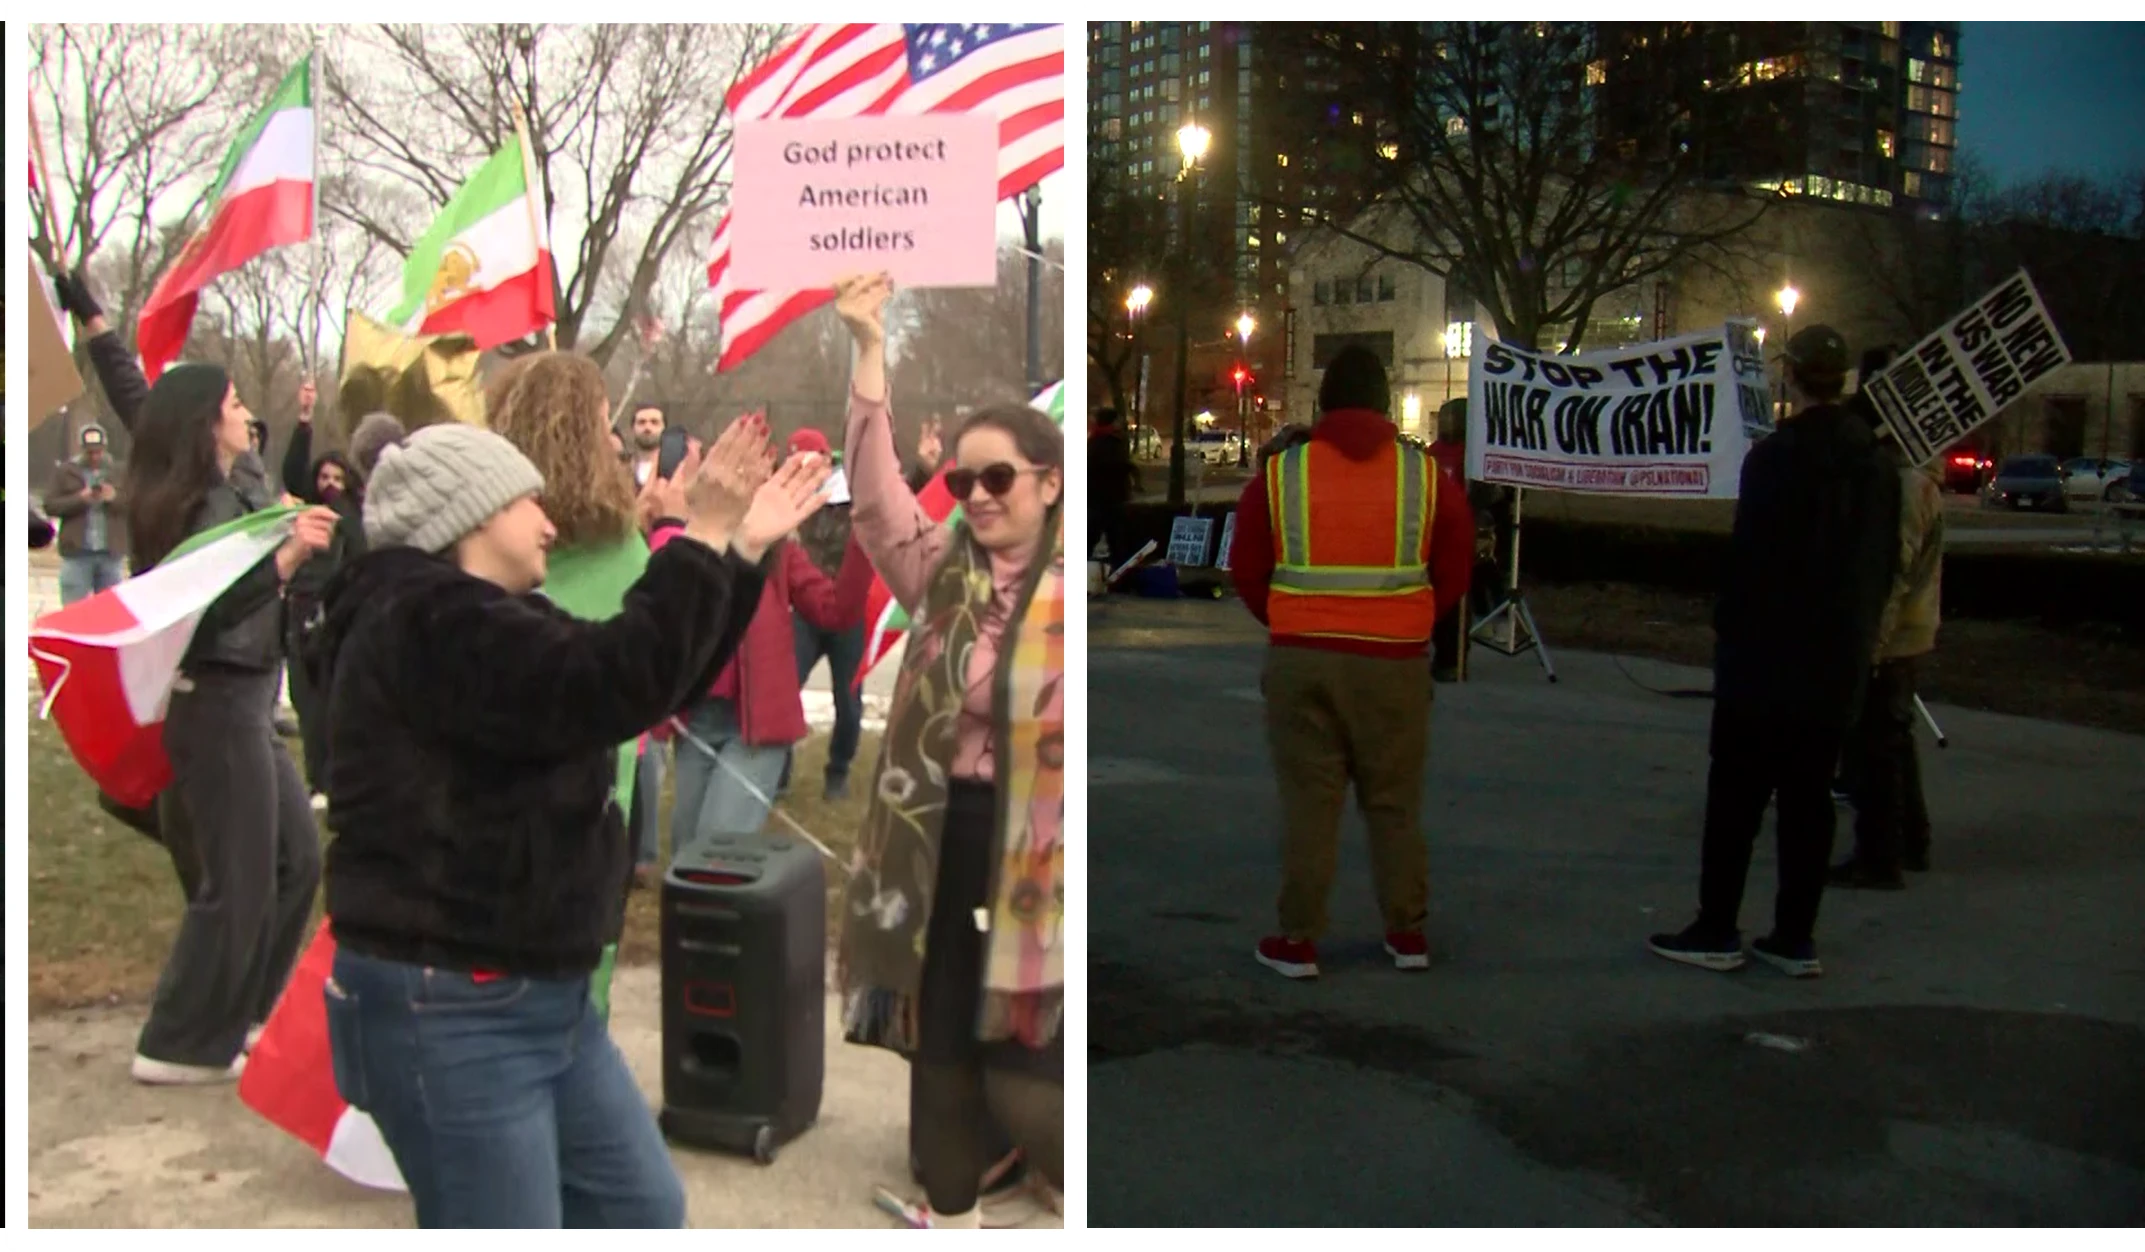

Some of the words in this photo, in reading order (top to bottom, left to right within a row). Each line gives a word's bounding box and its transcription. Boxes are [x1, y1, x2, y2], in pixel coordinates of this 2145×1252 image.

[783, 140, 838, 165] God
[847, 138, 946, 167] protect
[798, 183, 928, 208] American
[809, 227, 915, 251] soldiers
[1982, 278, 2034, 330] NO
[1952, 308, 1992, 353] US
[2002, 313, 2064, 385] NEW
[1483, 344, 1603, 390] STOP
[1609, 341, 1723, 387] THE
[1917, 335, 1954, 376] IN
[1936, 365, 1987, 430] THE
[1970, 339, 2023, 407] WAR
[1484, 381, 1551, 450] WAR
[1554, 395, 1611, 455] ON
[1611, 382, 1714, 455] IRAN!
[1918, 405, 1960, 450] EAST
